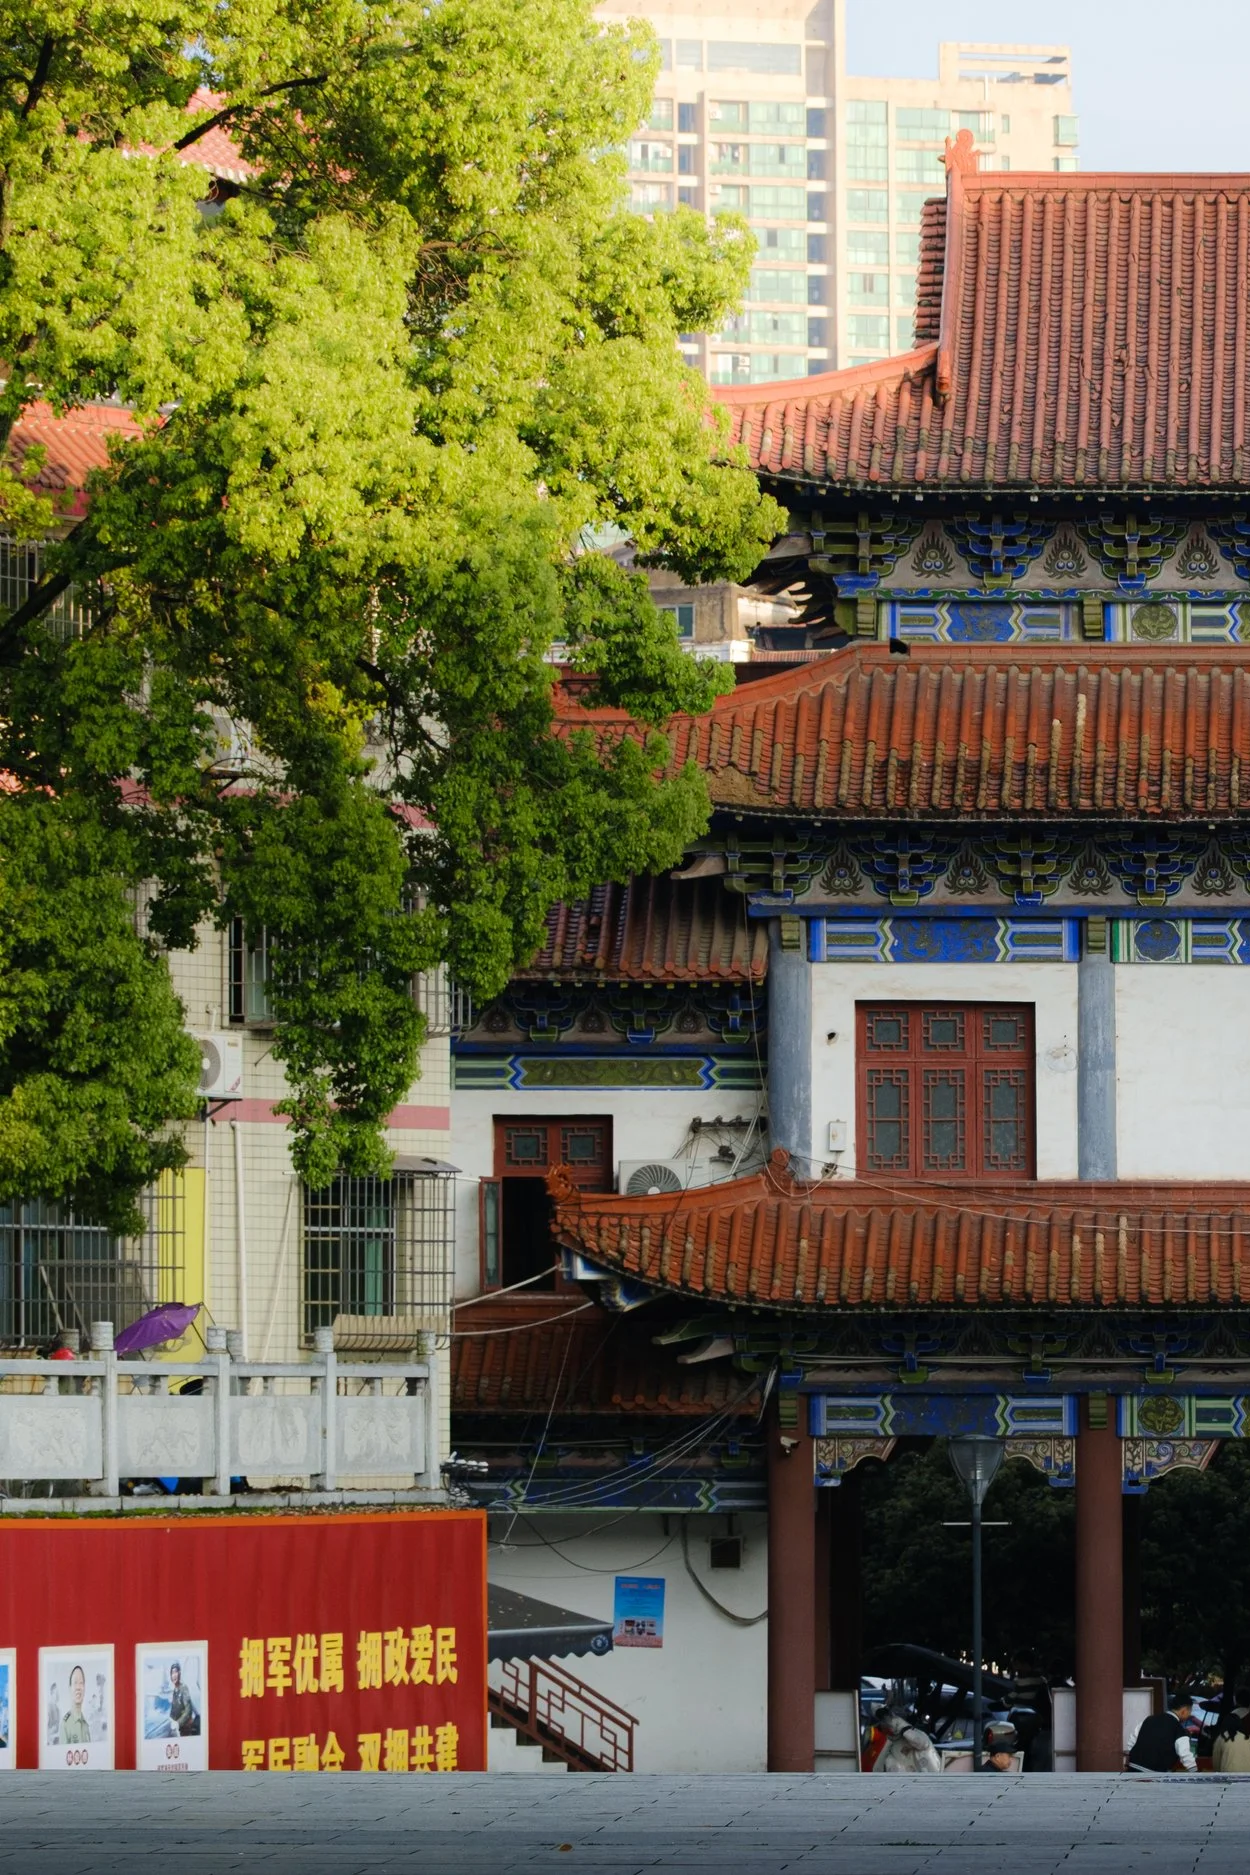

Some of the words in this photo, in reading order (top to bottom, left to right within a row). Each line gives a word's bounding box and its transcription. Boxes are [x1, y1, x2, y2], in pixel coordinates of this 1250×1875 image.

[239, 1632, 344, 1698] 拥军优属
[356, 1624, 458, 1690] 拥政爱民
